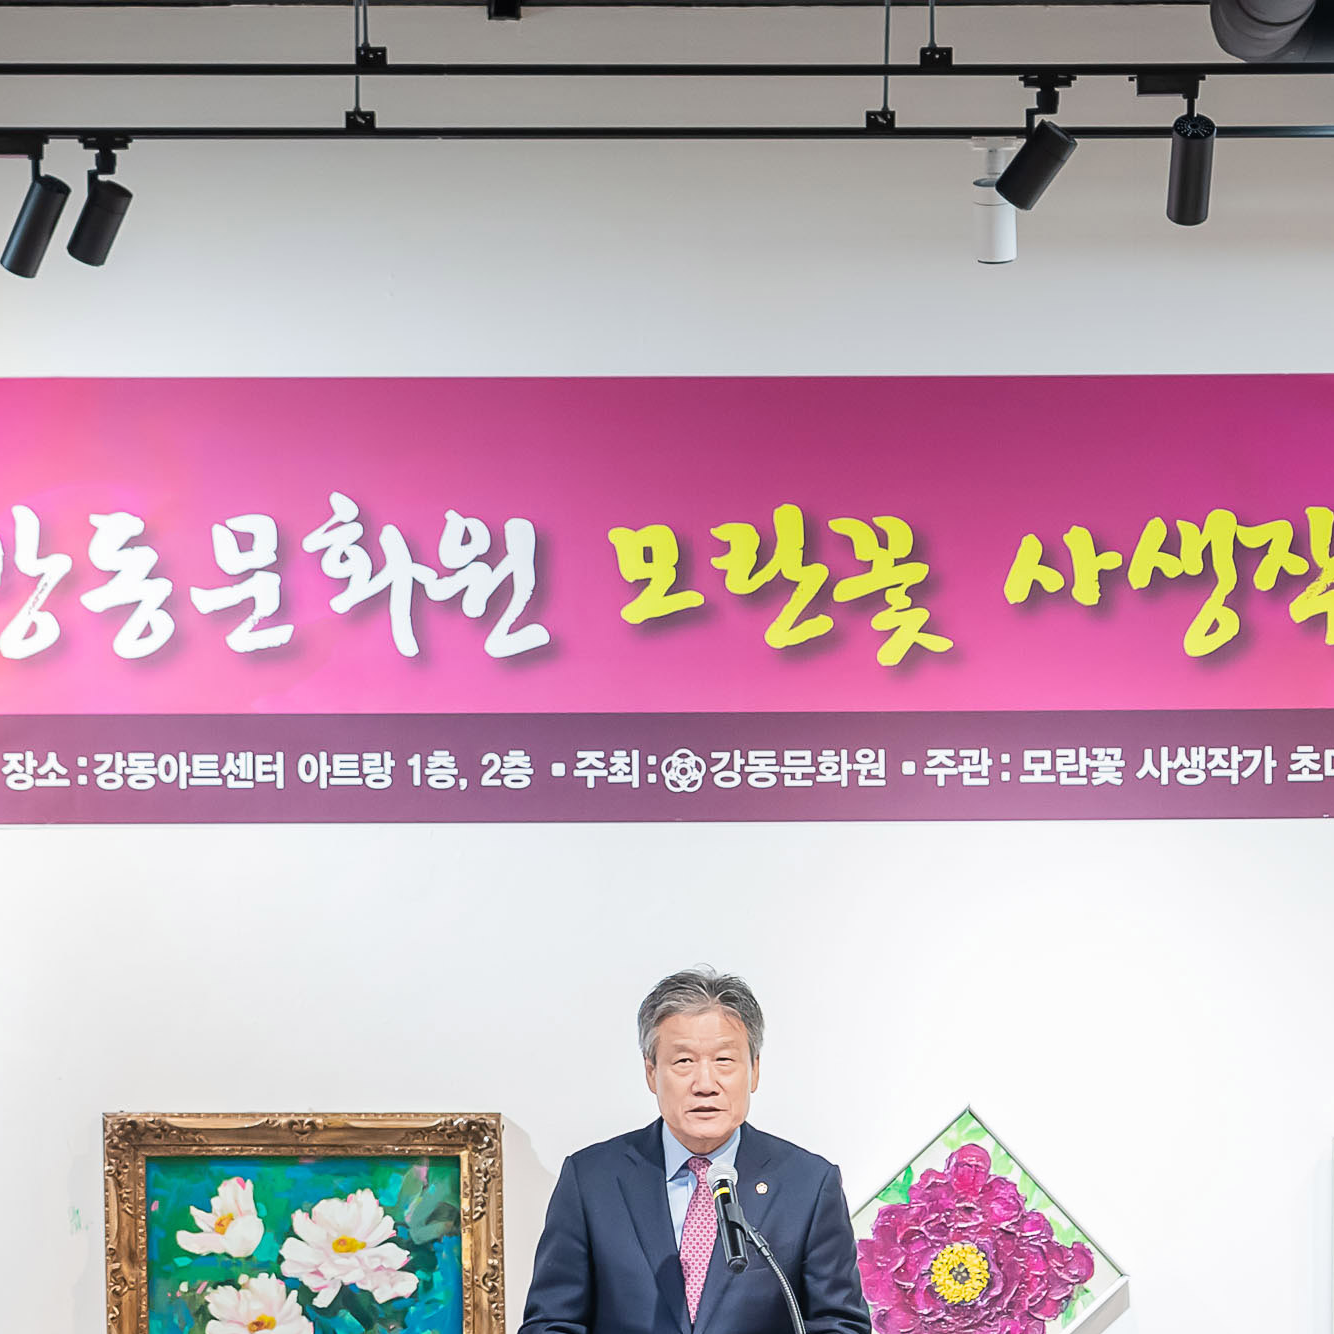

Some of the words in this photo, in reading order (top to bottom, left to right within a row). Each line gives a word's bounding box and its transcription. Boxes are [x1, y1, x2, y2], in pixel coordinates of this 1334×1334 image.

[607, 503, 953, 666] 모란꽃
[297, 751, 397, 790] 아트랑
[407, 750, 469, 791] 1층,
[481, 750, 535, 790] 2층
[710, 748, 887, 789] 강동문화원
[1135, 746, 1278, 786] 사생작가
